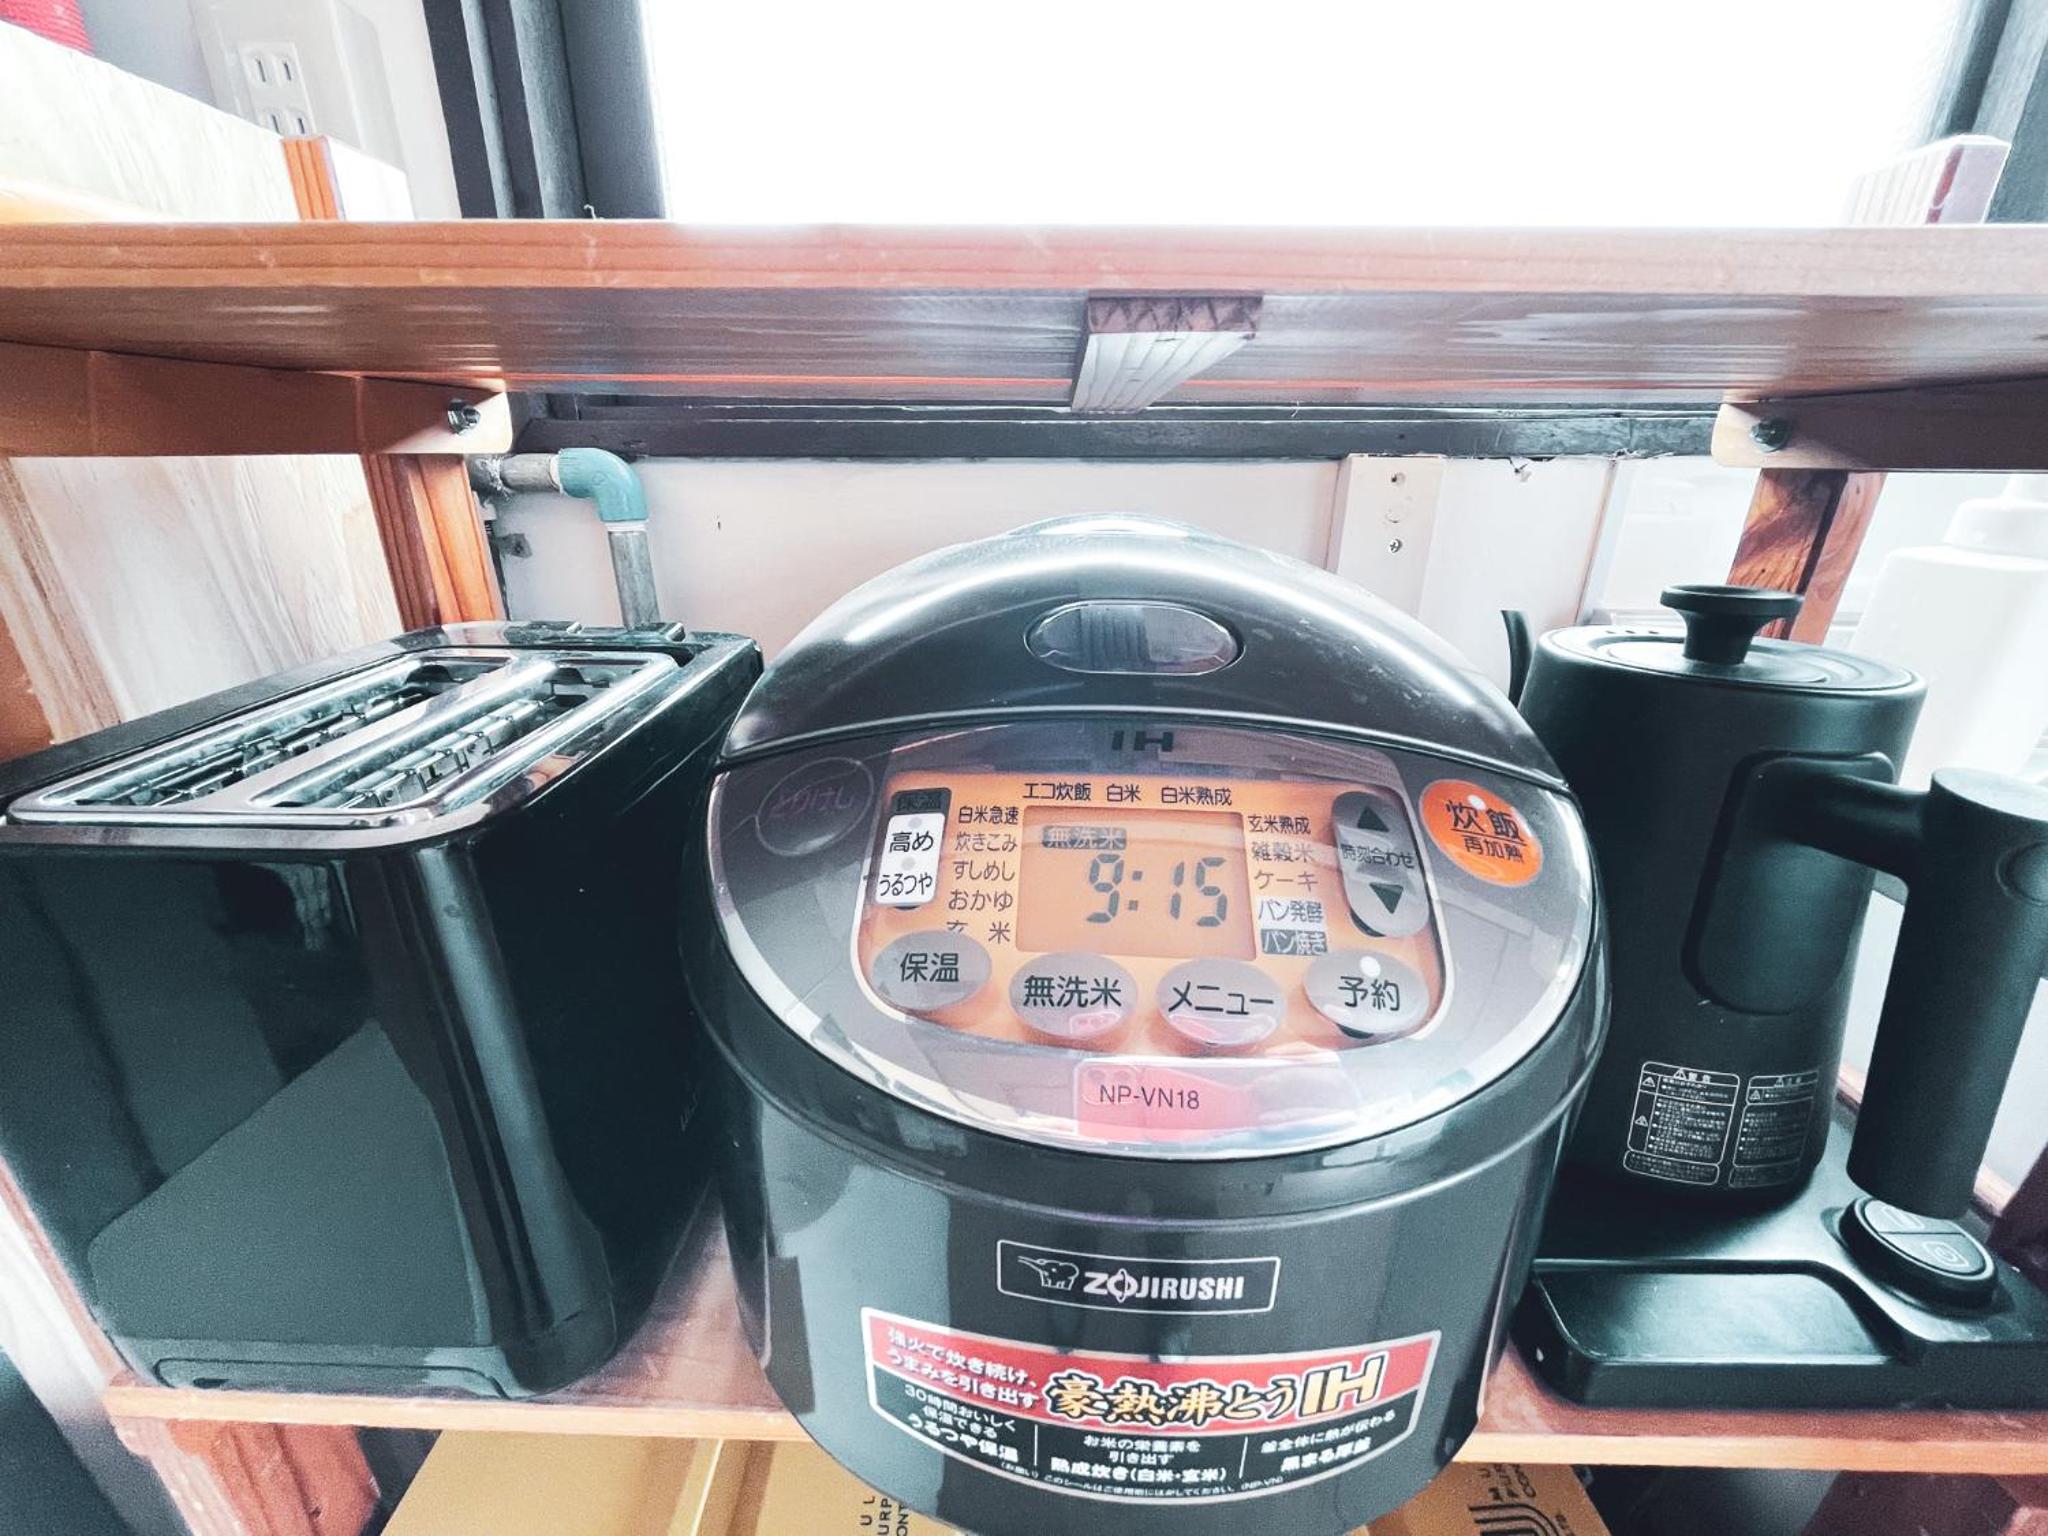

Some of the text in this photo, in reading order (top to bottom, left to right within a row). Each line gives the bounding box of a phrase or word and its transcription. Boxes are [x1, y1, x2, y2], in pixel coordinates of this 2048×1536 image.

[1022, 782, 1233, 806] エコ炊飯 白米 白米熟成
[958, 805, 1019, 825] 白米急速
[1248, 813, 1311, 835] 玄米熟成
[1444, 799, 1524, 843] 炊飯
[889, 830, 935, 853] 高め
[955, 831, 1018, 853] 炊きこみ
[1046, 826, 1126, 848] 無洗米
[1461, 835, 1525, 864] 再加熱
[1251, 840, 1314, 863] 雑穀米
[1340, 842, 1416, 869] 時刻合わせ
[953, 860, 1016, 881] すしめし
[1254, 870, 1319, 892] ケーキ
[879, 872, 933, 897] うるつや
[1086, 853, 1228, 928] 9:15
[948, 889, 1014, 912] おかゆ
[1258, 898, 1325, 924] パン発酵
[900, 952, 960, 983] 保温
[1023, 974, 1122, 1009] 無洗米
[1167, 980, 1274, 1015] メニュー
[1337, 975, 1401, 1012] 予約
[1099, 1084, 1200, 1110] NP-VN18
[1083, 1268, 1245, 1303] ZOJIRUSHI
[888, 1349, 1039, 1409] うまみを引き出す
[904, 1383, 1016, 1433] 30時間おいしく
[922, 1405, 998, 1439] 保温できる
[1108, 1451, 1175, 1466] 引き出す
